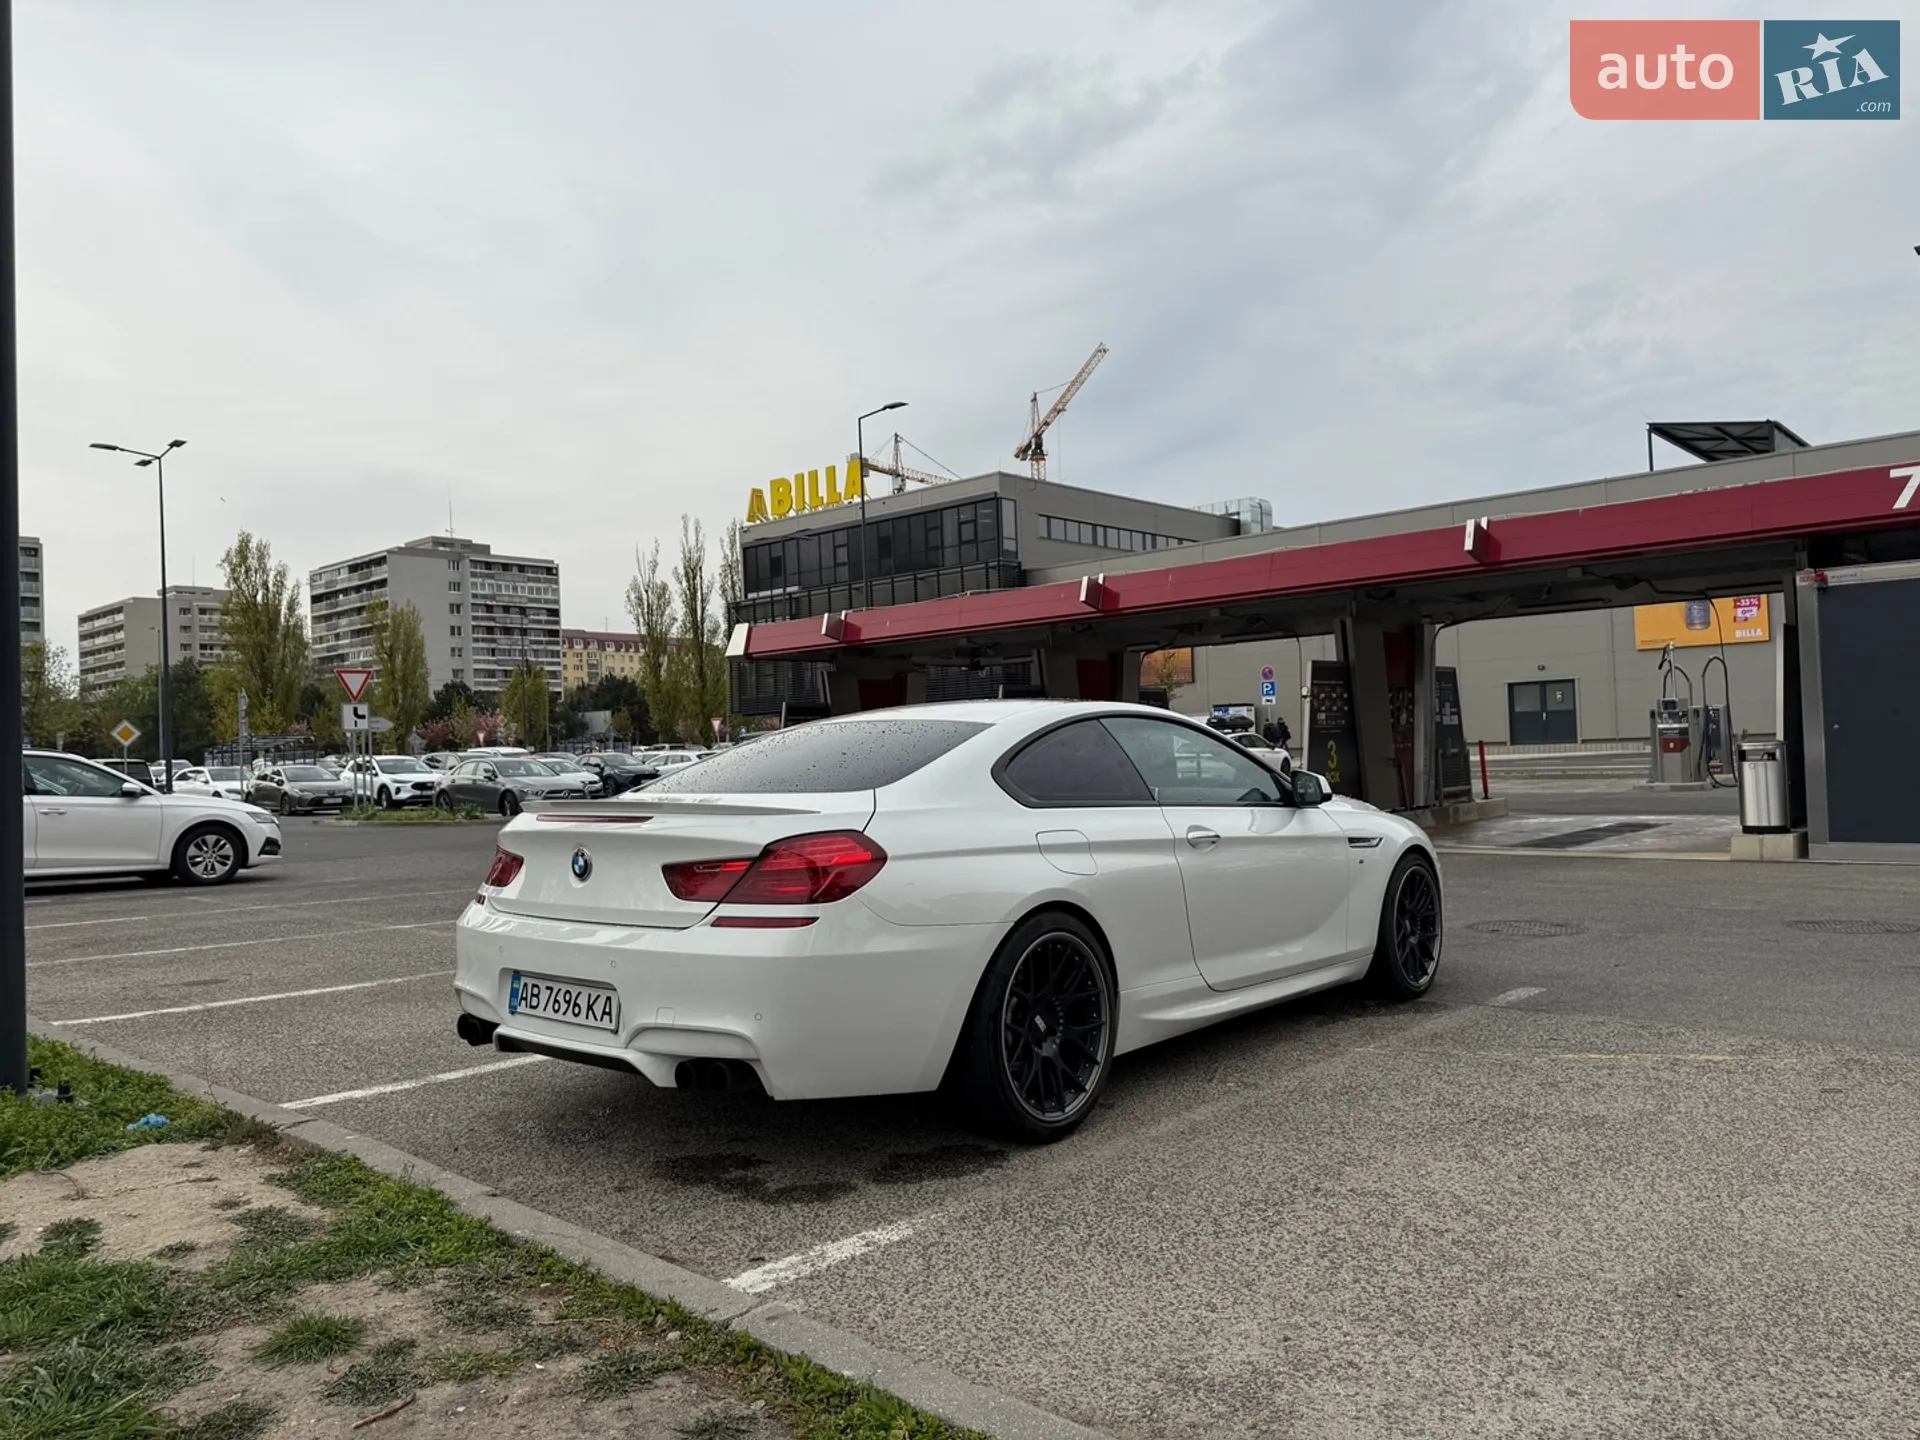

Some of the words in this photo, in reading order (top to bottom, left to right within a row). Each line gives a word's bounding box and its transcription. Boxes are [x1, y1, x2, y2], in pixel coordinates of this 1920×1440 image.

[1889, 465, 1920, 510] 7
[1735, 627, 1763, 638] BILLA
[1327, 739, 1338, 769] 3
